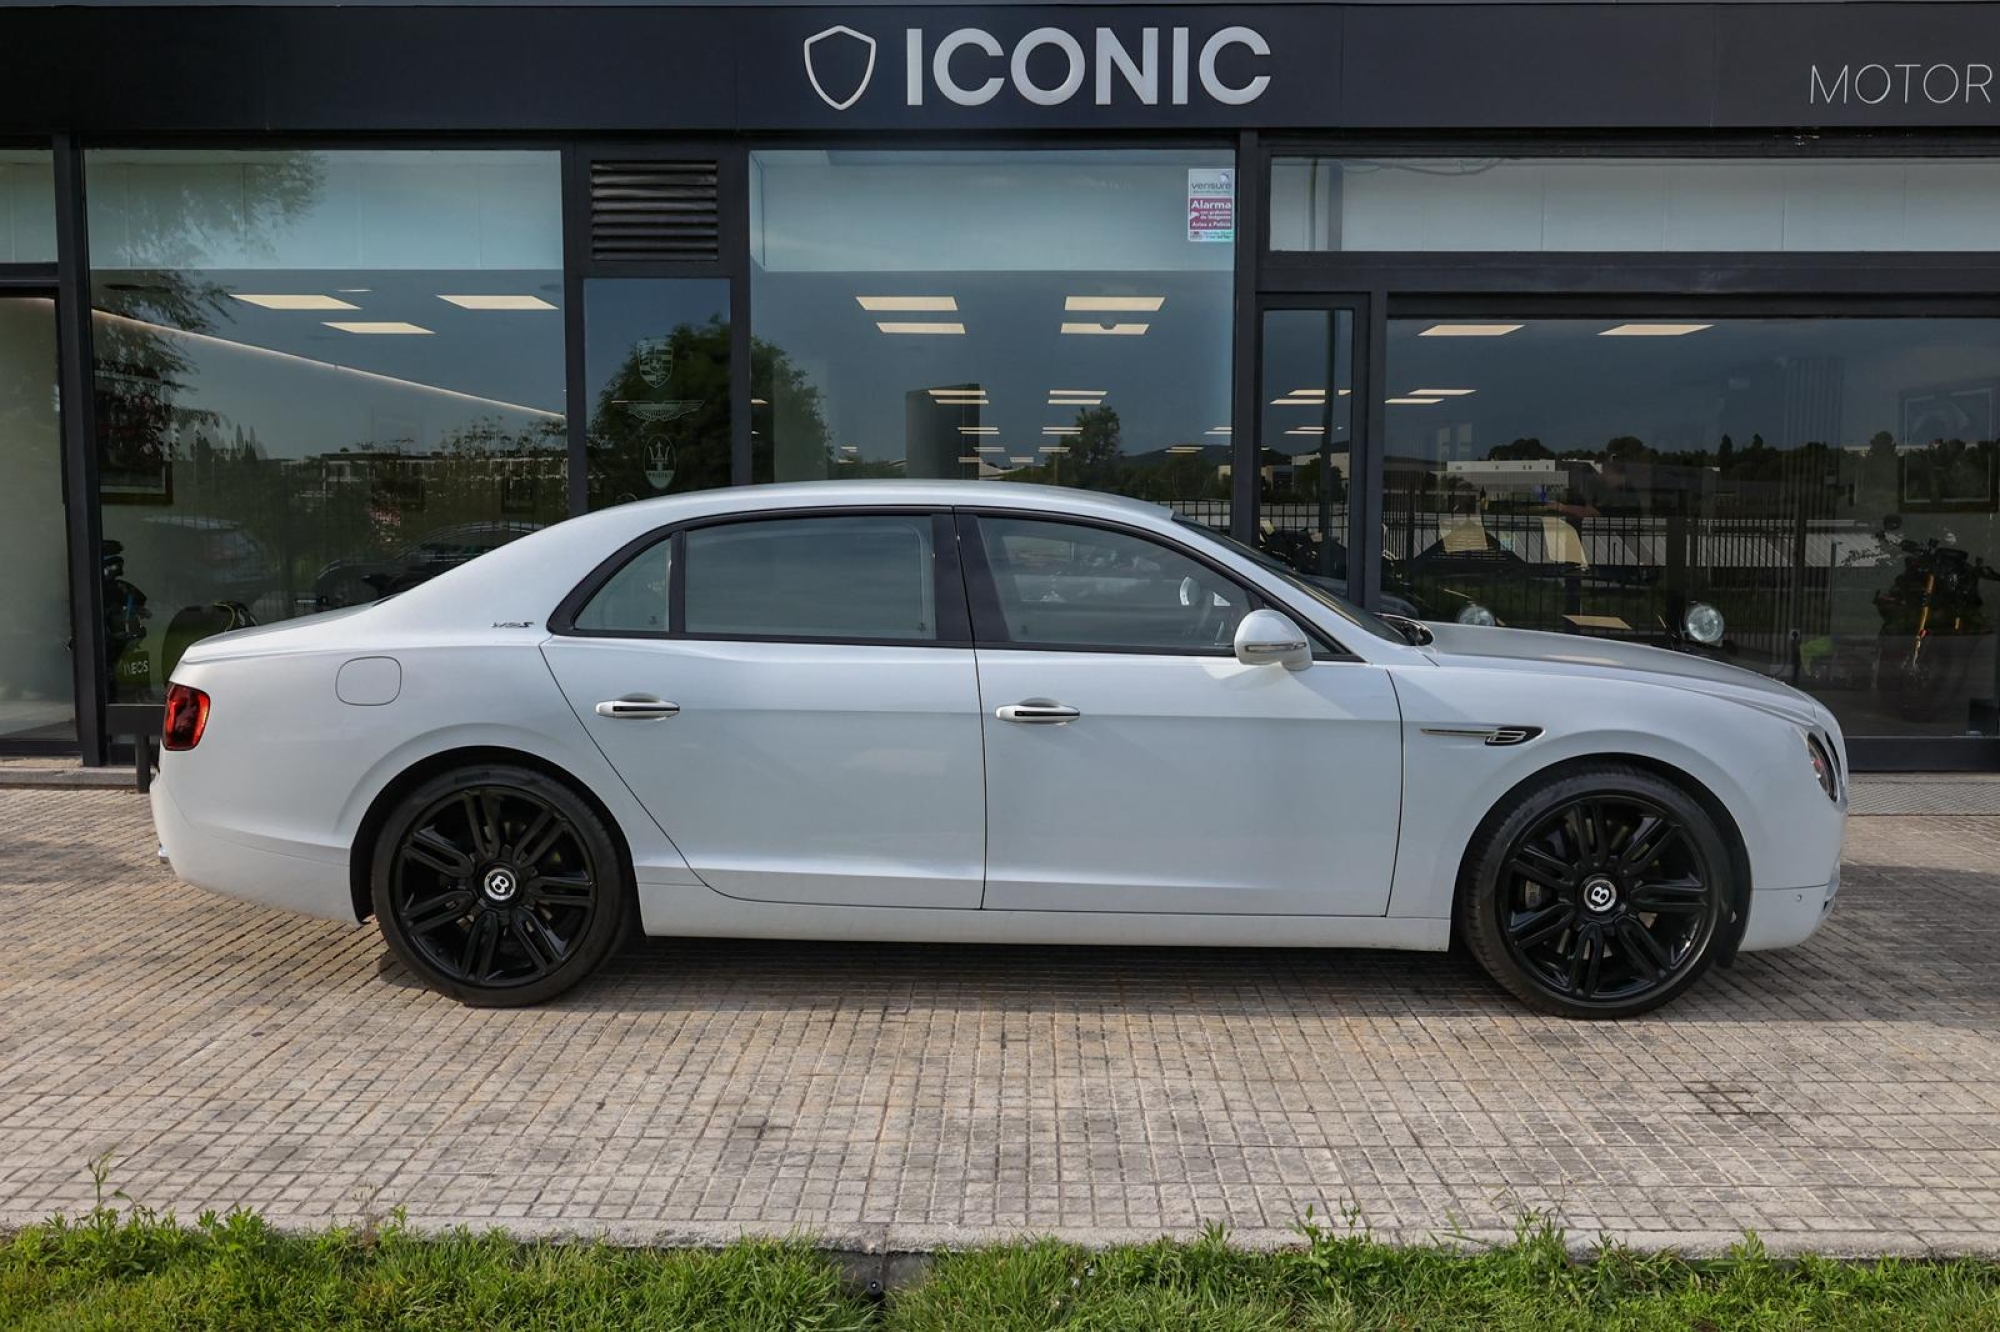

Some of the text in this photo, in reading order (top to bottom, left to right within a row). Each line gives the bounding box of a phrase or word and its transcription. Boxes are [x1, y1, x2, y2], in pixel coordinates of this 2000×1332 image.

[906, 26, 1271, 106] ICONIC
[1809, 63, 1993, 104] MOTOR
[1191, 200, 1231, 209] Alarma
